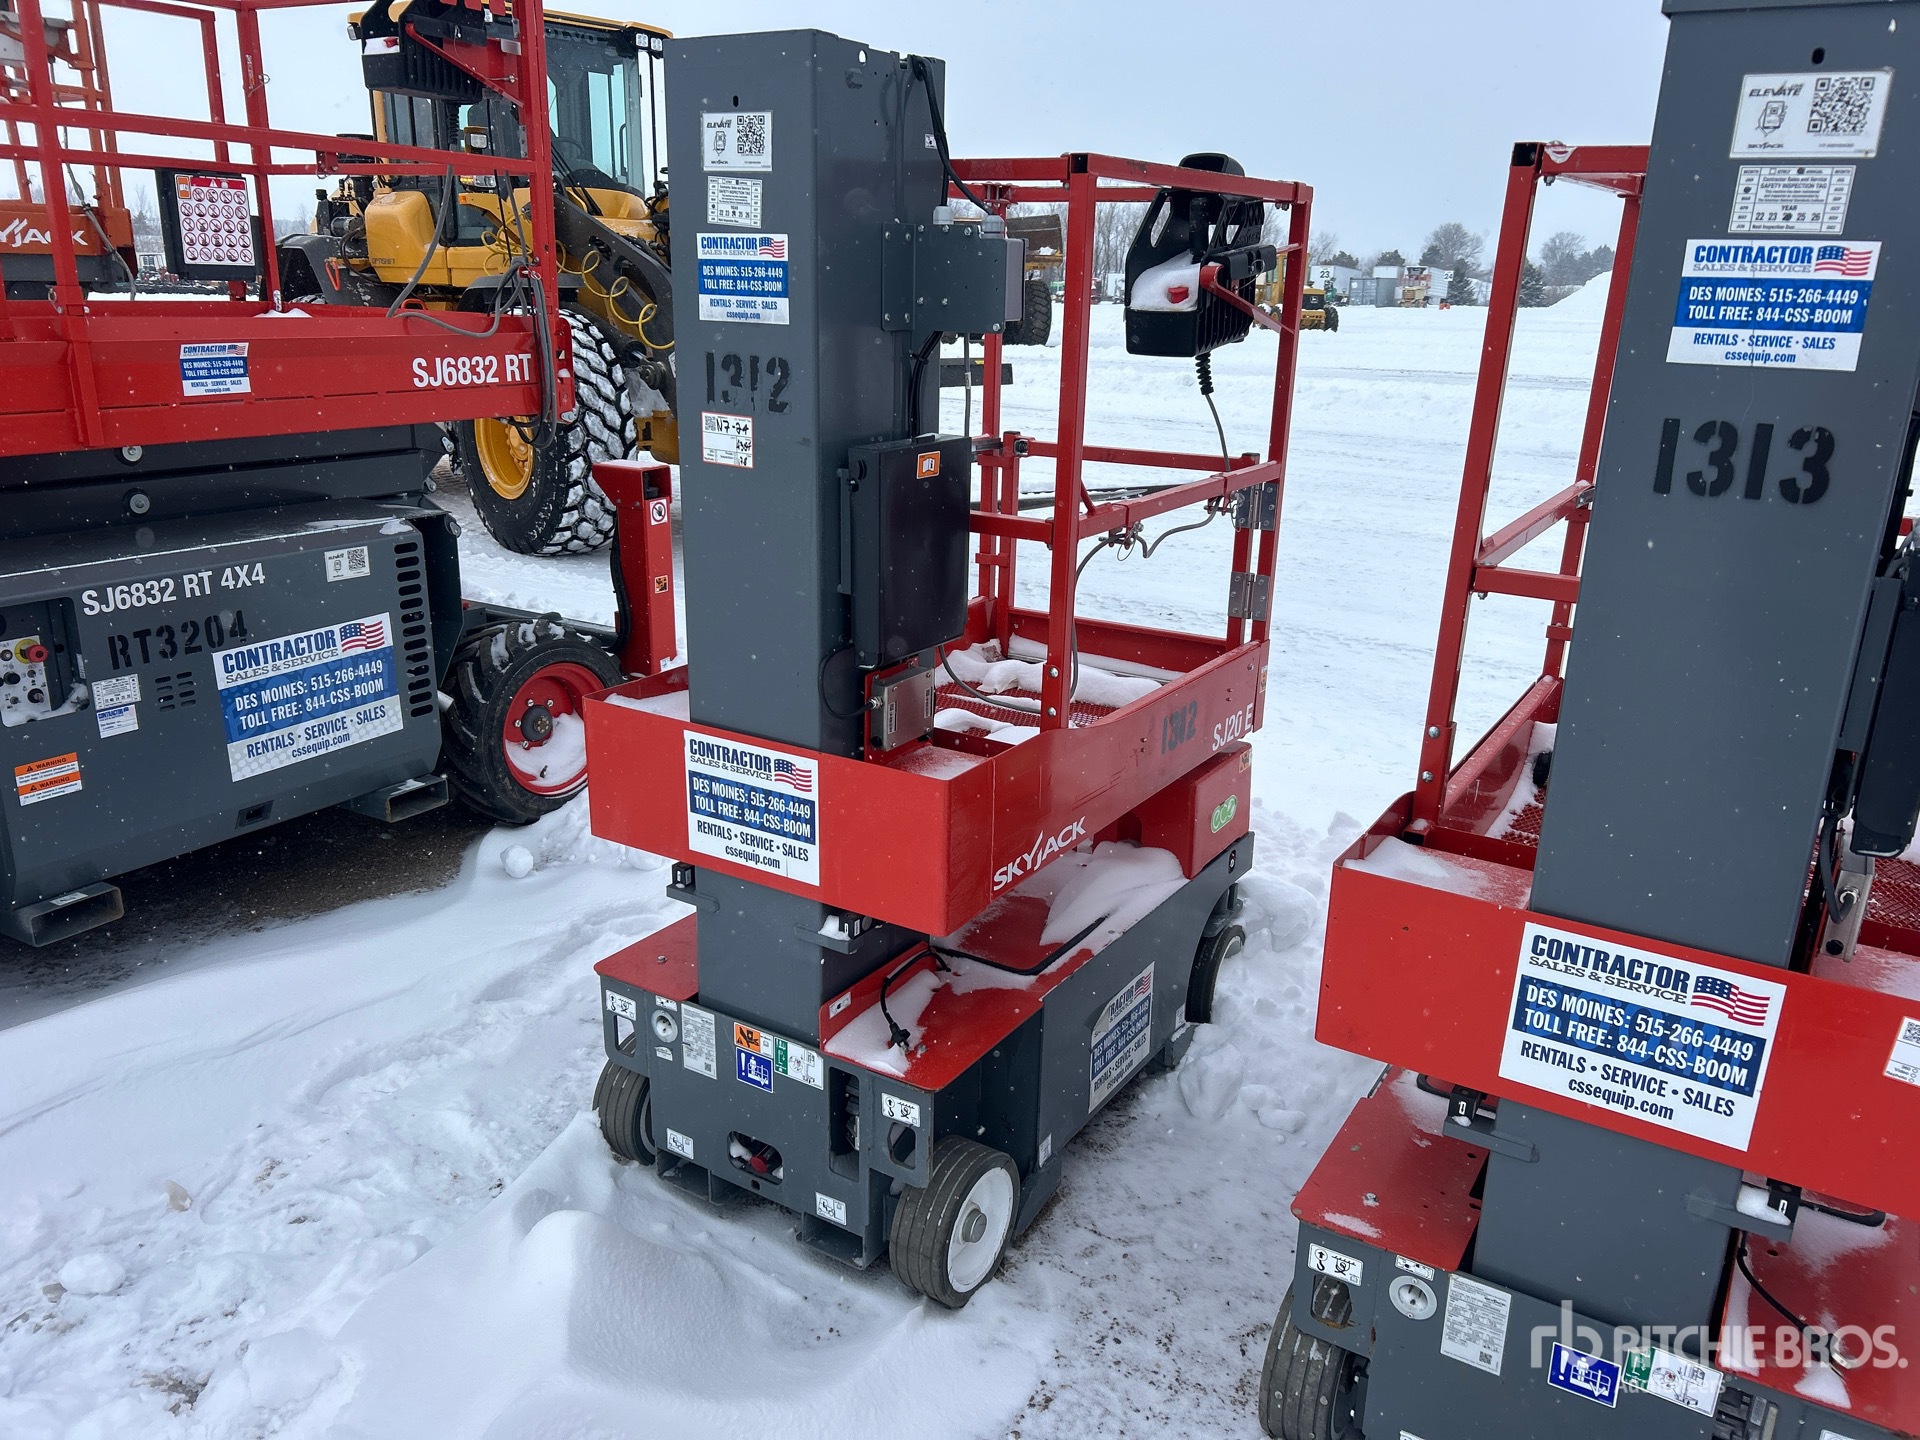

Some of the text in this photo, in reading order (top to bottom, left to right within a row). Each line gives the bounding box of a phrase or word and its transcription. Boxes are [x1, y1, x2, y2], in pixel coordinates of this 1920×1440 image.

[1749, 81, 1802, 97] ELEVATE
[701, 236, 757, 250] CONTRACTOR
[1694, 245, 1814, 264] CONTRACTOR
[703, 266, 783, 278] DES MOINES: 515-266-4449
[704, 278, 782, 291] TOLL FREE: 844-CSS-BOOM
[1693, 264, 1736, 272] SALES
[1750, 264, 1811, 273] SERVICE
[710, 299, 777, 309] RENTALS SERVICE SALES
[1689, 286, 1858, 305] DES MOINES: 515-266-4449
[726, 310, 760, 320] cssequip.com
[1689, 305, 1853, 324] TOLL FREE: 844-CSS-BOOM
[1694, 333, 1835, 350] RENTALS SERVICE SALES
[1725, 350, 1796, 364] cssequip.com
[412, 354, 531, 388] SJ6832 RT
[706, 352, 791, 413] 1312
[1653, 418, 1835, 504] 1313
[82, 562, 265, 616] SJ6832 RT 4X4
[108, 610, 248, 670] RT3204
[222, 629, 337, 674] CONTRACTOR
[226, 649, 338, 684] SALES & SERVICE
[235, 660, 383, 711] DES MOINES: 515-266-4449
[240, 678, 384, 730] TOLL FREE: 844-CSS-BOOM
[247, 705, 386, 758] RENTALS SERVICE SALES
[1212, 703, 1254, 751] SJ20 E
[292, 733, 350, 758] cssequip.com
[690, 738, 772, 773] CONTRACTOR
[36, 758, 66, 769] WARNING
[690, 755, 720, 769] SALES
[730, 765, 772, 781] SERVICE
[39, 777, 70, 788] WARNING
[693, 777, 810, 819] DES MOINES: 515-266-4449
[695, 795, 810, 838] TOLL FREE: 844-CSS-BOOM
[697, 820, 808, 862] RENTALS SERVICE SALES
[725, 846, 780, 869] cssequip.com
[993, 816, 1086, 891] SKYJACK
[1529, 956, 1687, 1004] SALES & SERVICE
[1531, 934, 1690, 994] CONTRACTOR
[1526, 984, 1754, 1062] DES MOINES: 515-266-4449
[1524, 1008, 1748, 1087] TOLL FREE: 844-CSS-BOOM
[1520, 1041, 1735, 1118] RENTALS SERVICE SALES
[1568, 1078, 1674, 1120] cssequip.com
